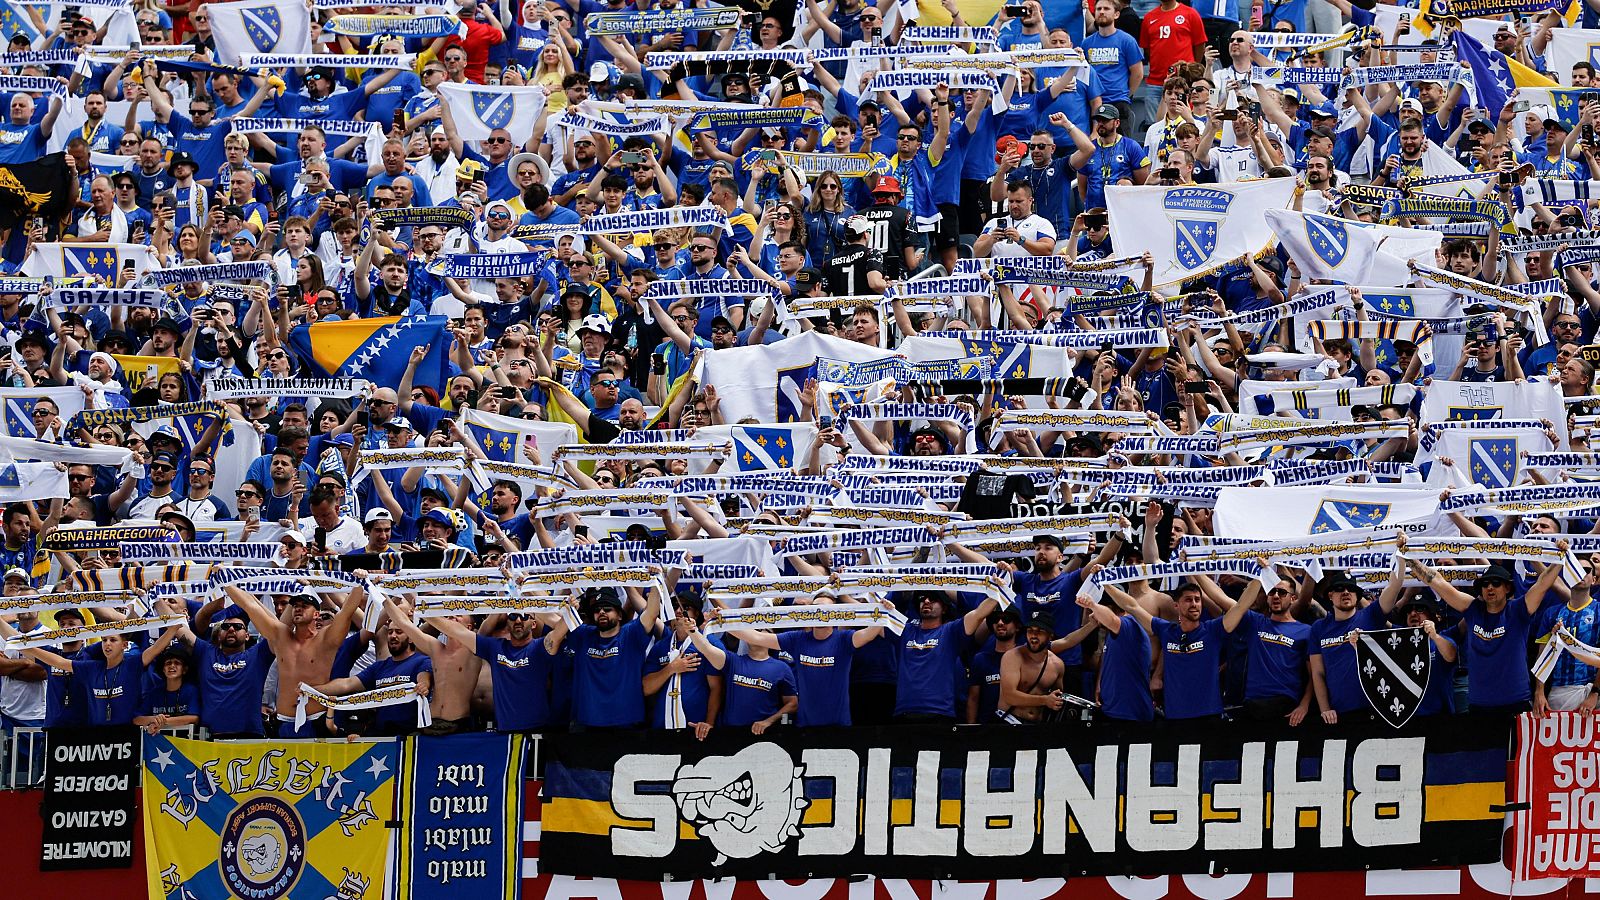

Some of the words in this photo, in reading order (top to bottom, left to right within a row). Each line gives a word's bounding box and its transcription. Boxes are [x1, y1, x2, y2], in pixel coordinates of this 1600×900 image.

[339, 18, 368, 31] BOSNIA
[389, 17, 442, 34] HERZEGOVINA
[606, 22, 639, 31] BOSNA
[645, 18, 715, 30] HERCEGOVINA
[1160, 26, 1170, 38] 19
[1293, 72, 1341, 83] HERZEGO
[711, 112, 739, 121] BOSNA
[745, 108, 802, 119] HERCEGOVINA
[236, 118, 283, 131] BOSNA
[1238, 160, 1247, 172] 10
[470, 256, 510, 266] BOSNIA
[511, 255, 521, 264] &
[162, 268, 198, 284] BOSNIA
[199, 263, 264, 280] HERZEGOVINA
[455, 262, 535, 277] HERZEGOVINA
[60, 291, 155, 306] GAZIJE
[214, 379, 254, 392] BOSNA
[256, 379, 262, 389] I
[266, 378, 353, 391] HERCEGOVINA
[83, 407, 136, 426] BOSNA
[1527, 454, 1582, 466] BOSNA
[46, 529, 85, 542] BOSNA
[94, 527, 176, 541] HERCEGOVINA
[122, 545, 171, 559] BOSNA
[630, 550, 683, 564] BOSNA
[54, 742, 132, 762] SLAVIMO
[53, 774, 129, 792] POBJEDE
[52, 808, 127, 829] GAZIMO
[43, 840, 131, 860] KILOMETRE
